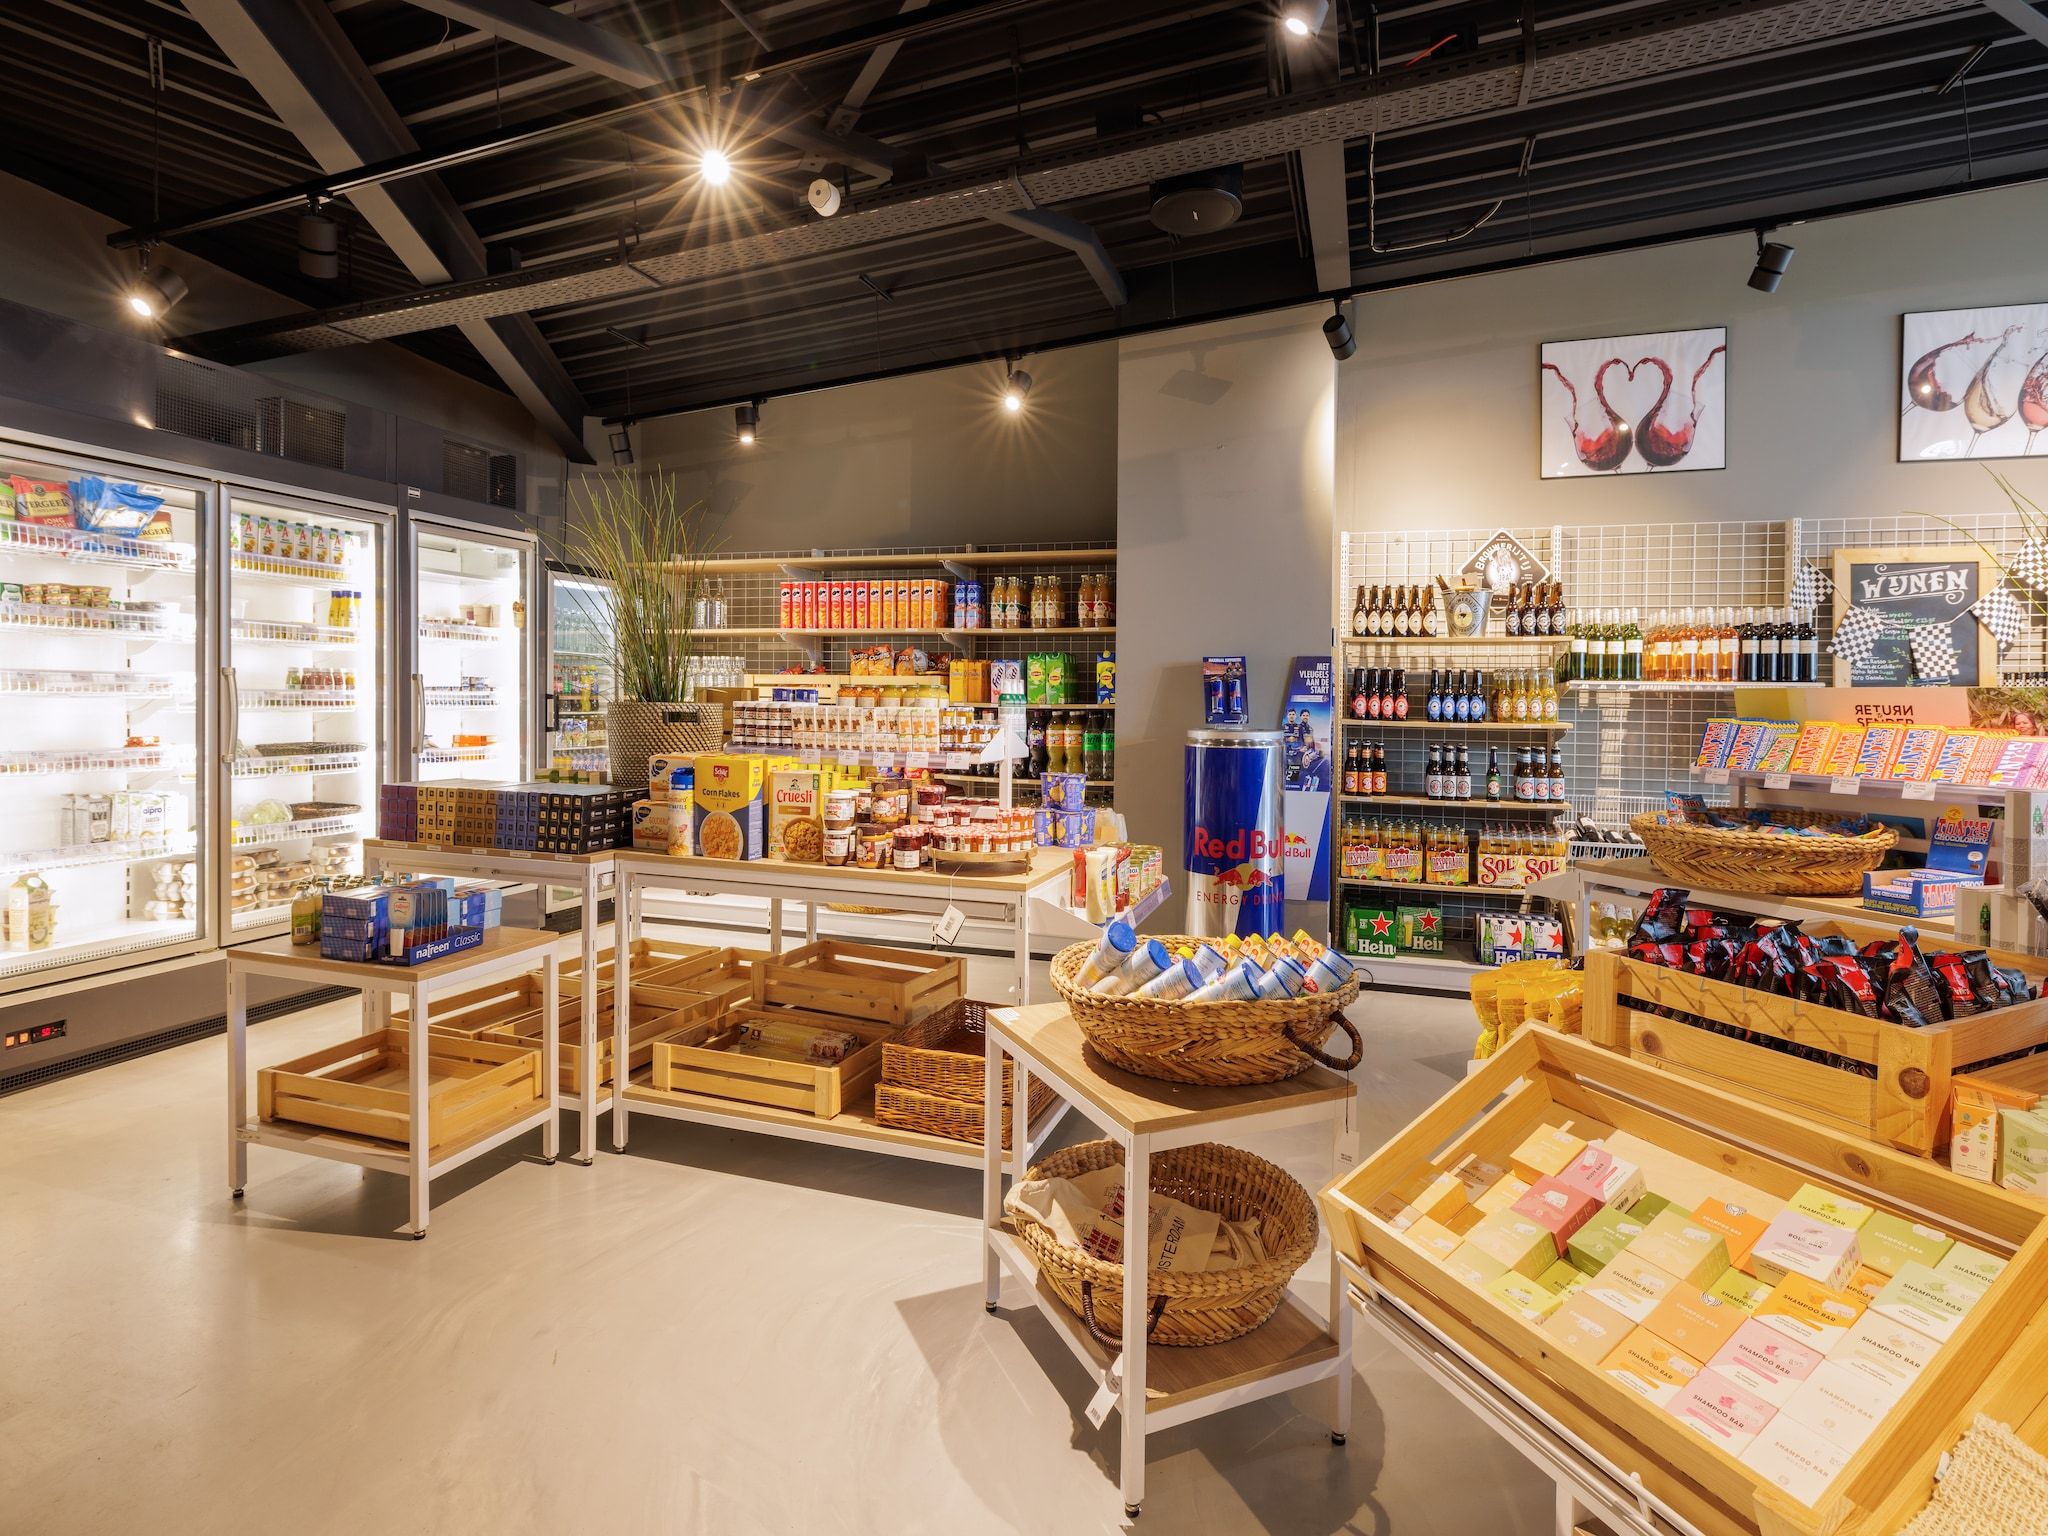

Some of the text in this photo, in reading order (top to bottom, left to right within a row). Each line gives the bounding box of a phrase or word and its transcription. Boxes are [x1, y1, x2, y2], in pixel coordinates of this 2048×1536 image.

[1299, 670, 1329, 678] VLEUGELS
[1305, 678, 1329, 686] AAN DE
[1310, 686, 1329, 694] START
[702, 788, 740, 798] Corn Flakes
[776, 789, 812, 804] Cruesli
[143, 807, 162, 815] alpro
[1937, 817, 1991, 839] TONY'S
[1193, 826, 1284, 859] Red Bul
[1934, 833, 1989, 845] CHOCOLONELY
[1196, 890, 1247, 905] ENERGY
[454, 932, 481, 948] Classic
[1358, 938, 1396, 955] Hein
[1799, 1204, 1846, 1226] SHAMPOO BAR
[1613, 1270, 1655, 1296] SHAMPOO BAR
[1953, 1264, 1994, 1283] SHAMPOO
[1721, 1290, 1754, 1310] SHAMPOO
[1903, 1283, 1963, 1312] SHAMPOO BAR
[1783, 1294, 1837, 1322] SHAMPOO BAR
[1738, 1343, 1792, 1375] SHAMPOO BAR
[1861, 1336, 1921, 1369] SHAMPOO BAR
[1628, 1349, 1673, 1380] SHAMPOO BAR
[1693, 1394, 1745, 1429] SHAMPOO BAR
[1775, 1441, 1812, 1466] SHAMPOO
[1812, 1464, 1829, 1478] BAR
